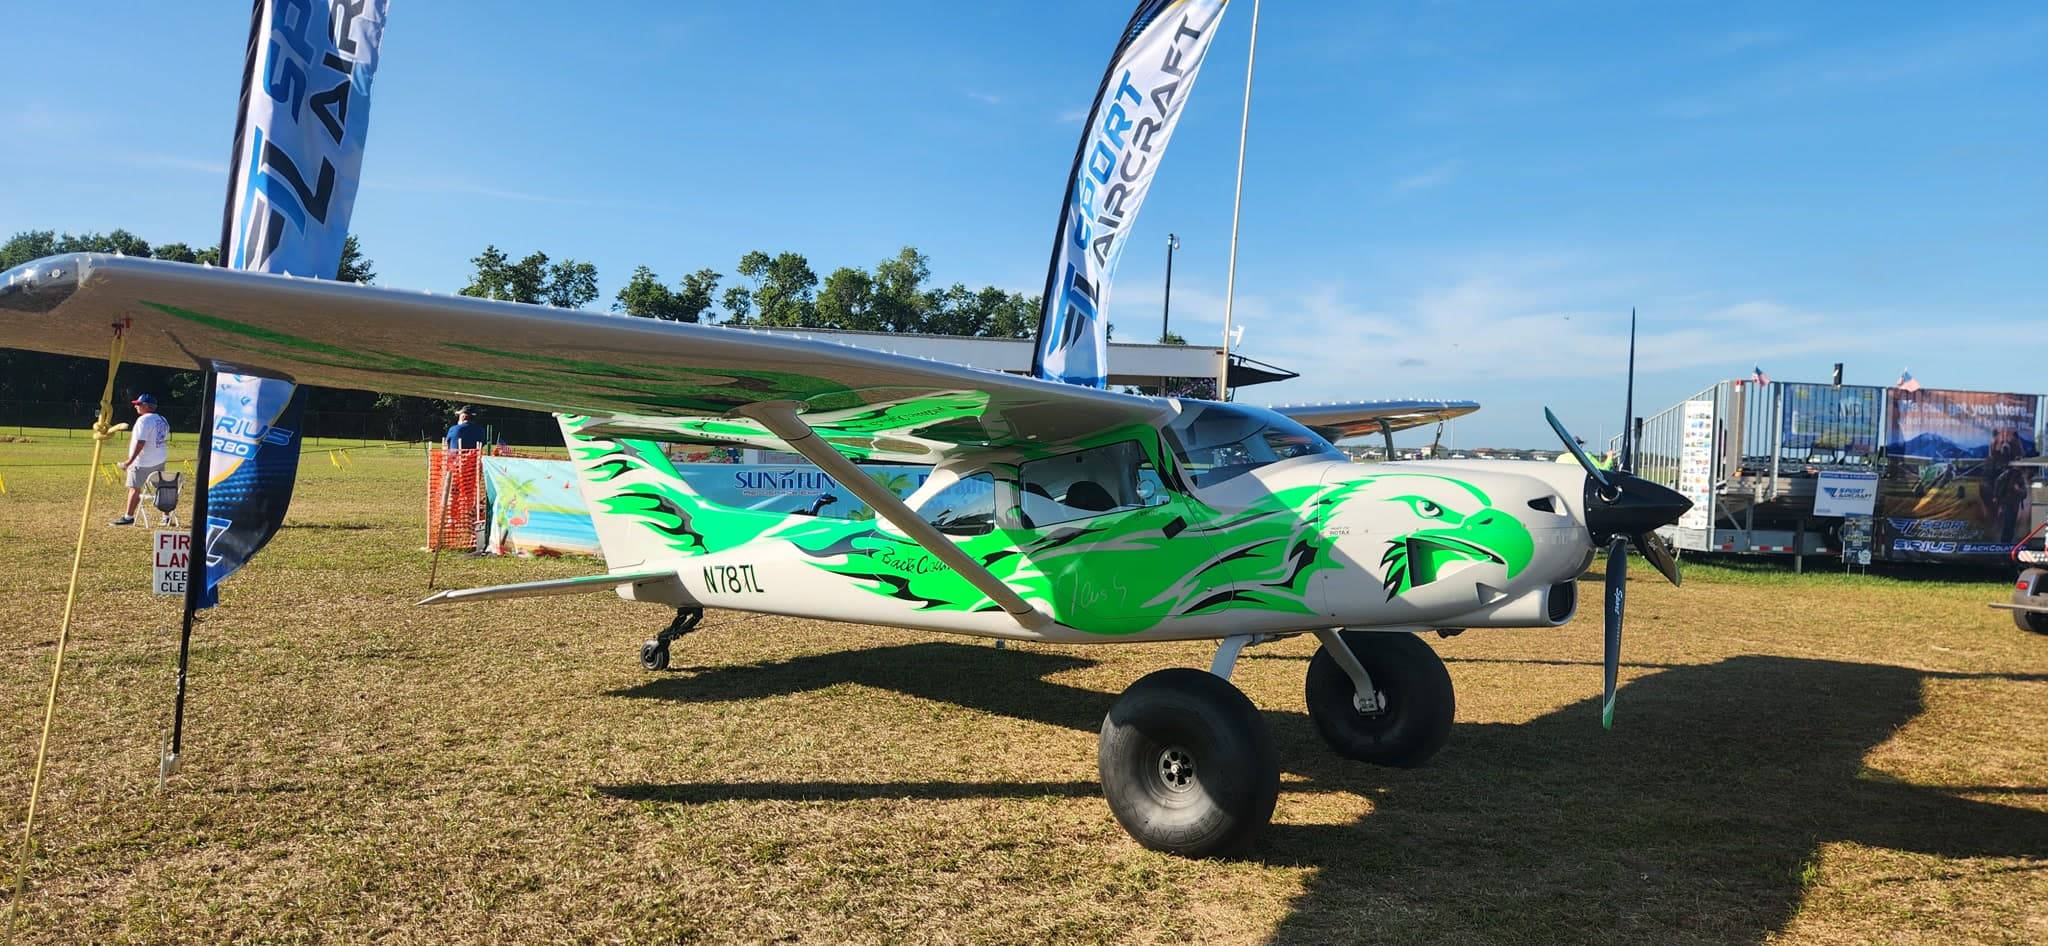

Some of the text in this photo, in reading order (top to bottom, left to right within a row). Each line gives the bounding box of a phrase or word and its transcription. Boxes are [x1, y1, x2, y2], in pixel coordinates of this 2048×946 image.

[1092, 13, 1201, 269] AIRCRAFT
[1074, 69, 1143, 250] SPORT
[1971, 404, 1993, 416] you
[215, 415, 294, 446] RIUS
[212, 439, 249, 455] RBO
[735, 471, 777, 489] SUN
[797, 471, 836, 489] FUN
[1919, 520, 1968, 530] SPORT
[160, 534, 191, 550] FIR
[1893, 539, 1957, 553] SIRIUS
[156, 552, 190, 568] LAN
[165, 570, 188, 582] KEE
[703, 564, 765, 594] N78TL
[161, 582, 186, 593] CLE
